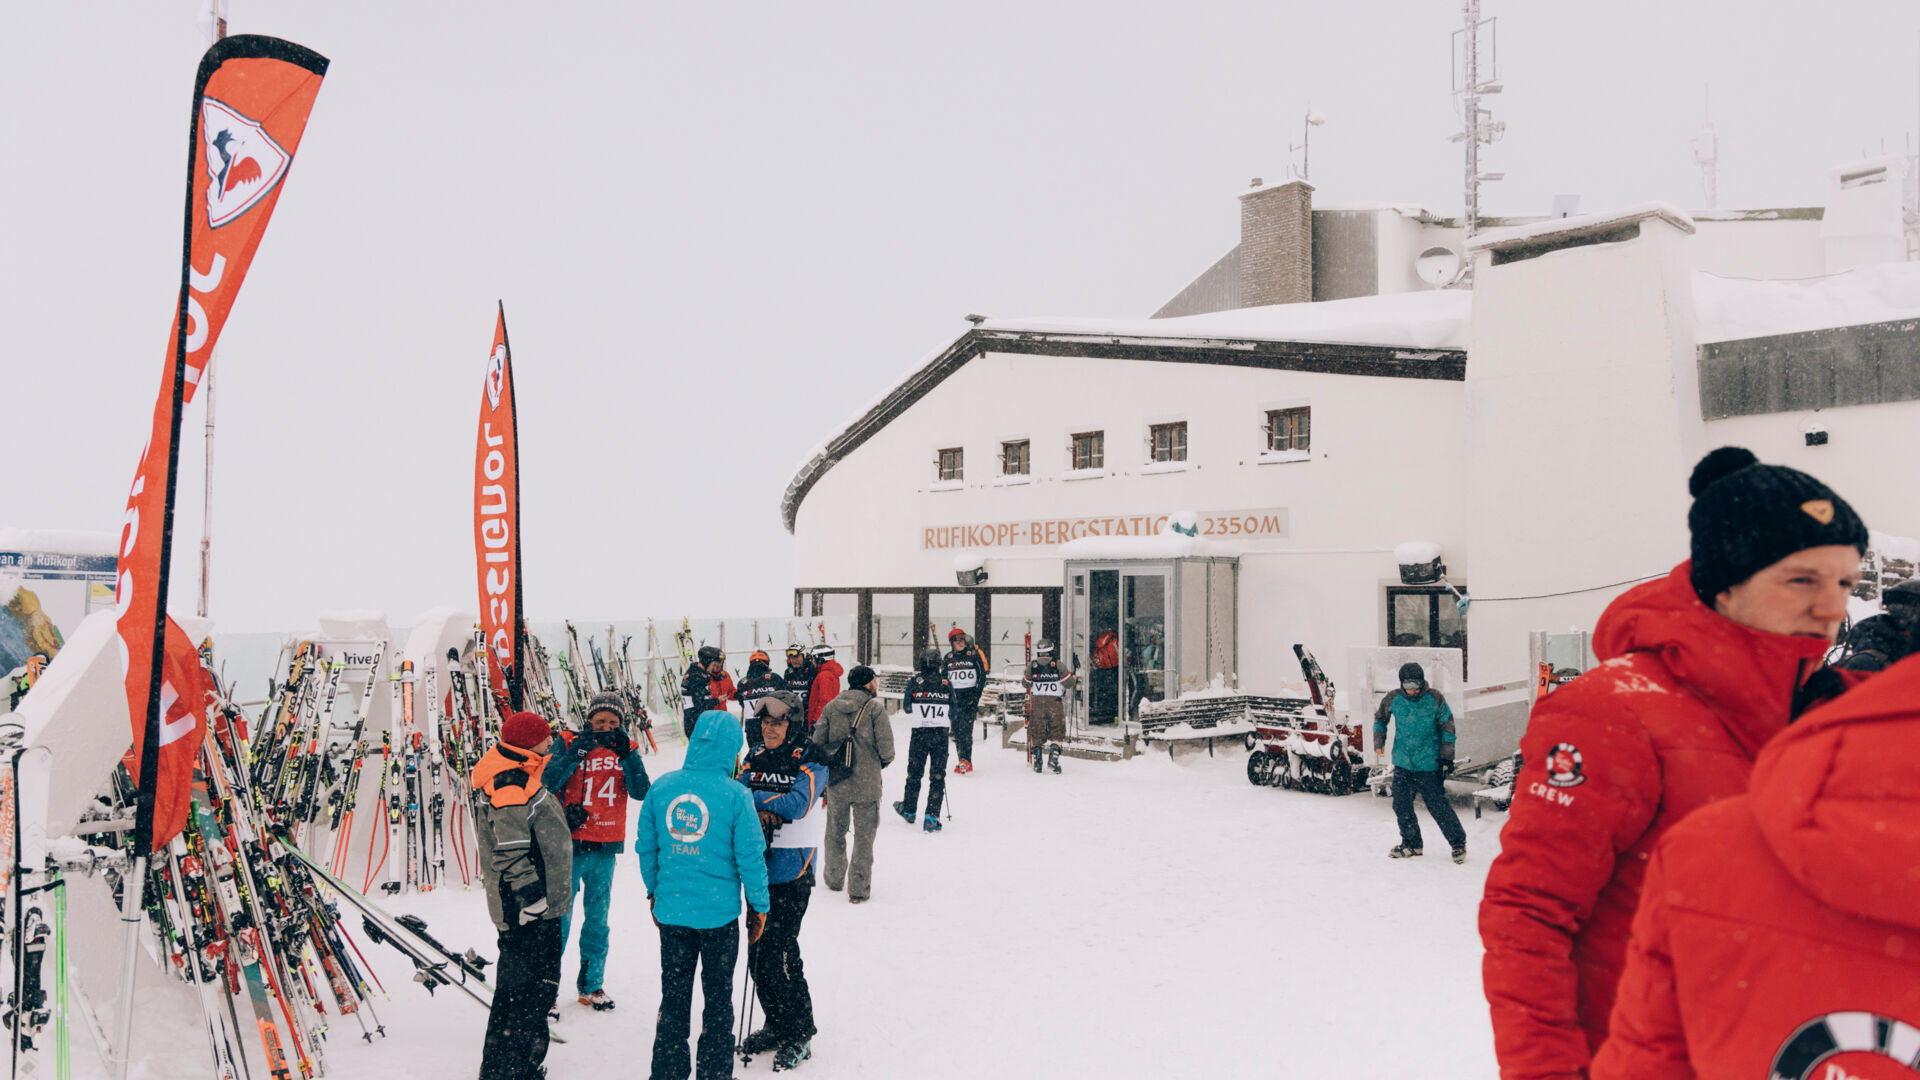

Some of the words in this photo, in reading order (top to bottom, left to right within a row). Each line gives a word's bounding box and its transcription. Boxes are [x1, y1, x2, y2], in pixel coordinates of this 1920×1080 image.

[1203, 515, 1281, 536] 2350M
[0, 555, 14, 565] an
[364, 653, 381, 697] HEAD
[948, 670, 974, 680] V106
[1035, 683, 1058, 692] V70
[920, 705, 944, 719] V14
[579, 756, 624, 771] RESS
[582, 776, 617, 807] 14
[1529, 782, 1575, 807] CREW
[671, 844, 700, 855] TEAM
